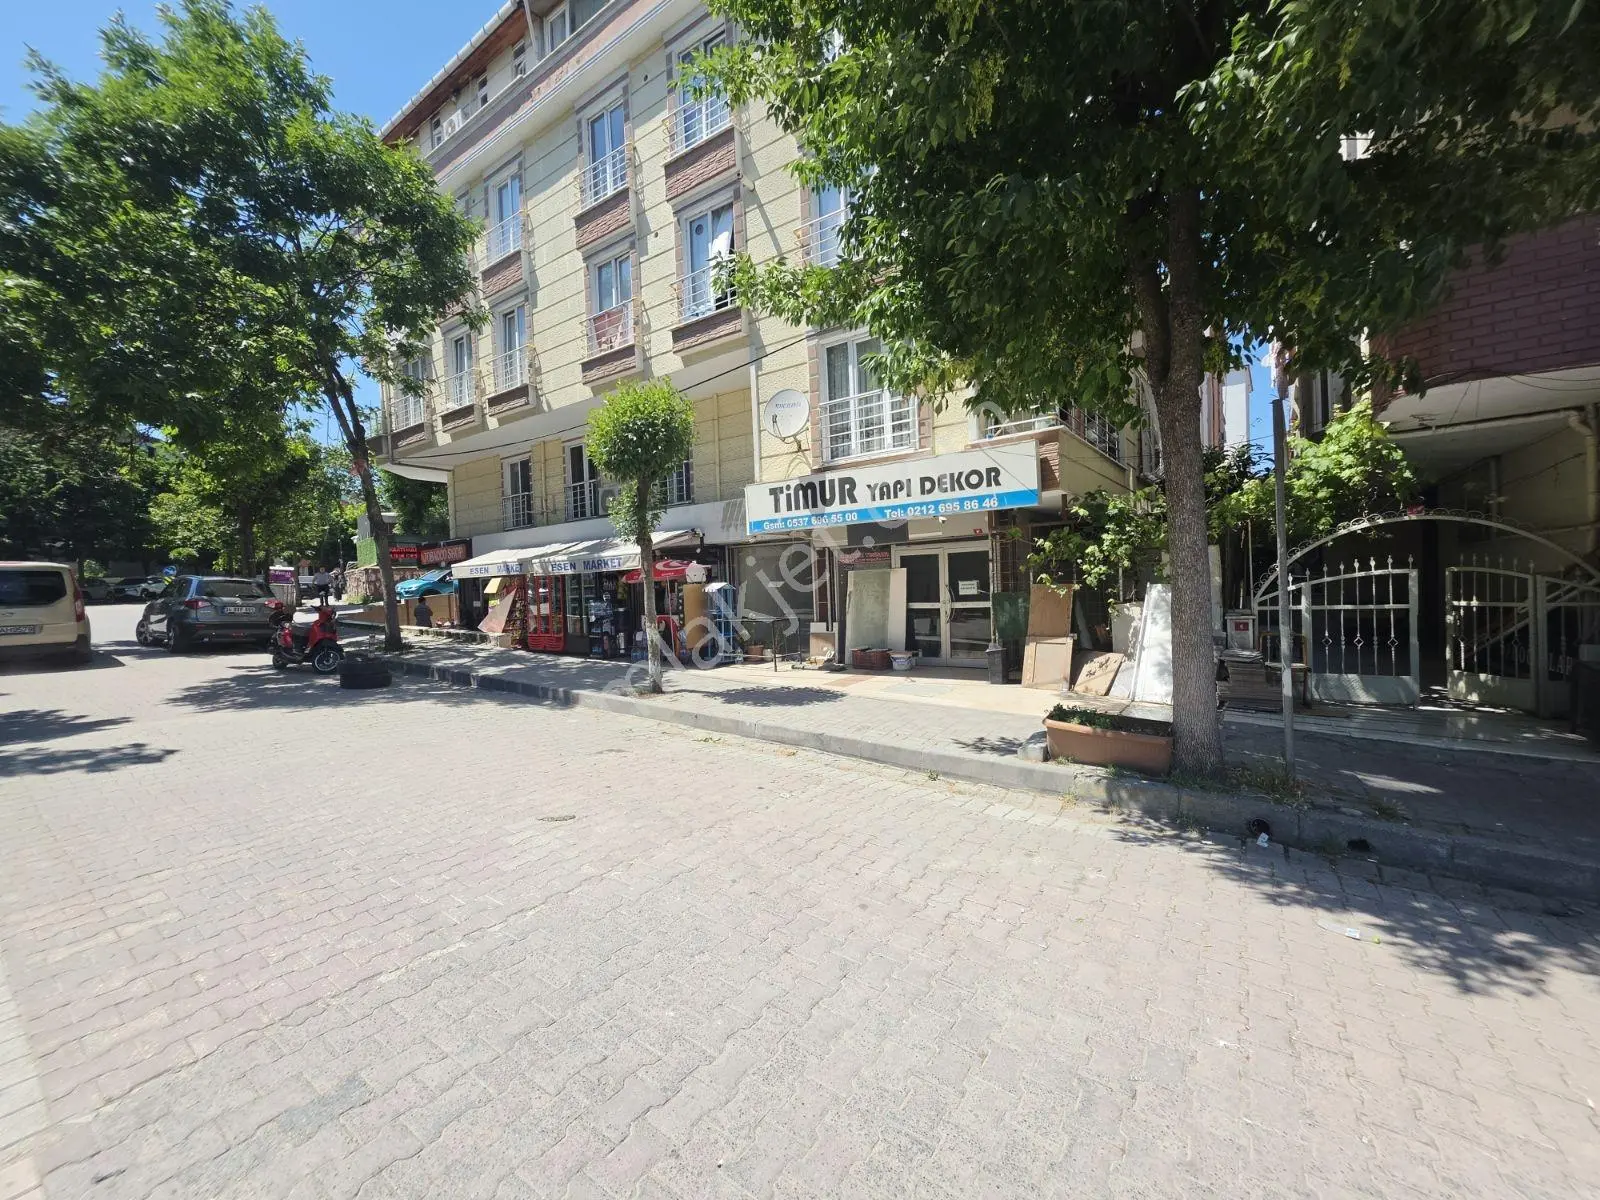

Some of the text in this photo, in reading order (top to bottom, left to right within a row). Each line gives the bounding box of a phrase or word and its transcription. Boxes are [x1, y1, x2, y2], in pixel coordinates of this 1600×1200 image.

[866, 478, 912, 501] YAPI
[919, 467, 1001, 496] DEKOR
[884, 508, 904, 519] Tel:
[907, 505, 936, 516] 0212
[938, 504, 960, 514] 695
[963, 499, 979, 510] 86
[763, 521, 785, 531] Gsm:
[787, 517, 808, 528] 0537
[845, 511, 858, 521] 00
[469, 563, 524, 575] ESEN MARKET
[550, 557, 622, 572] ESEN MARKET
